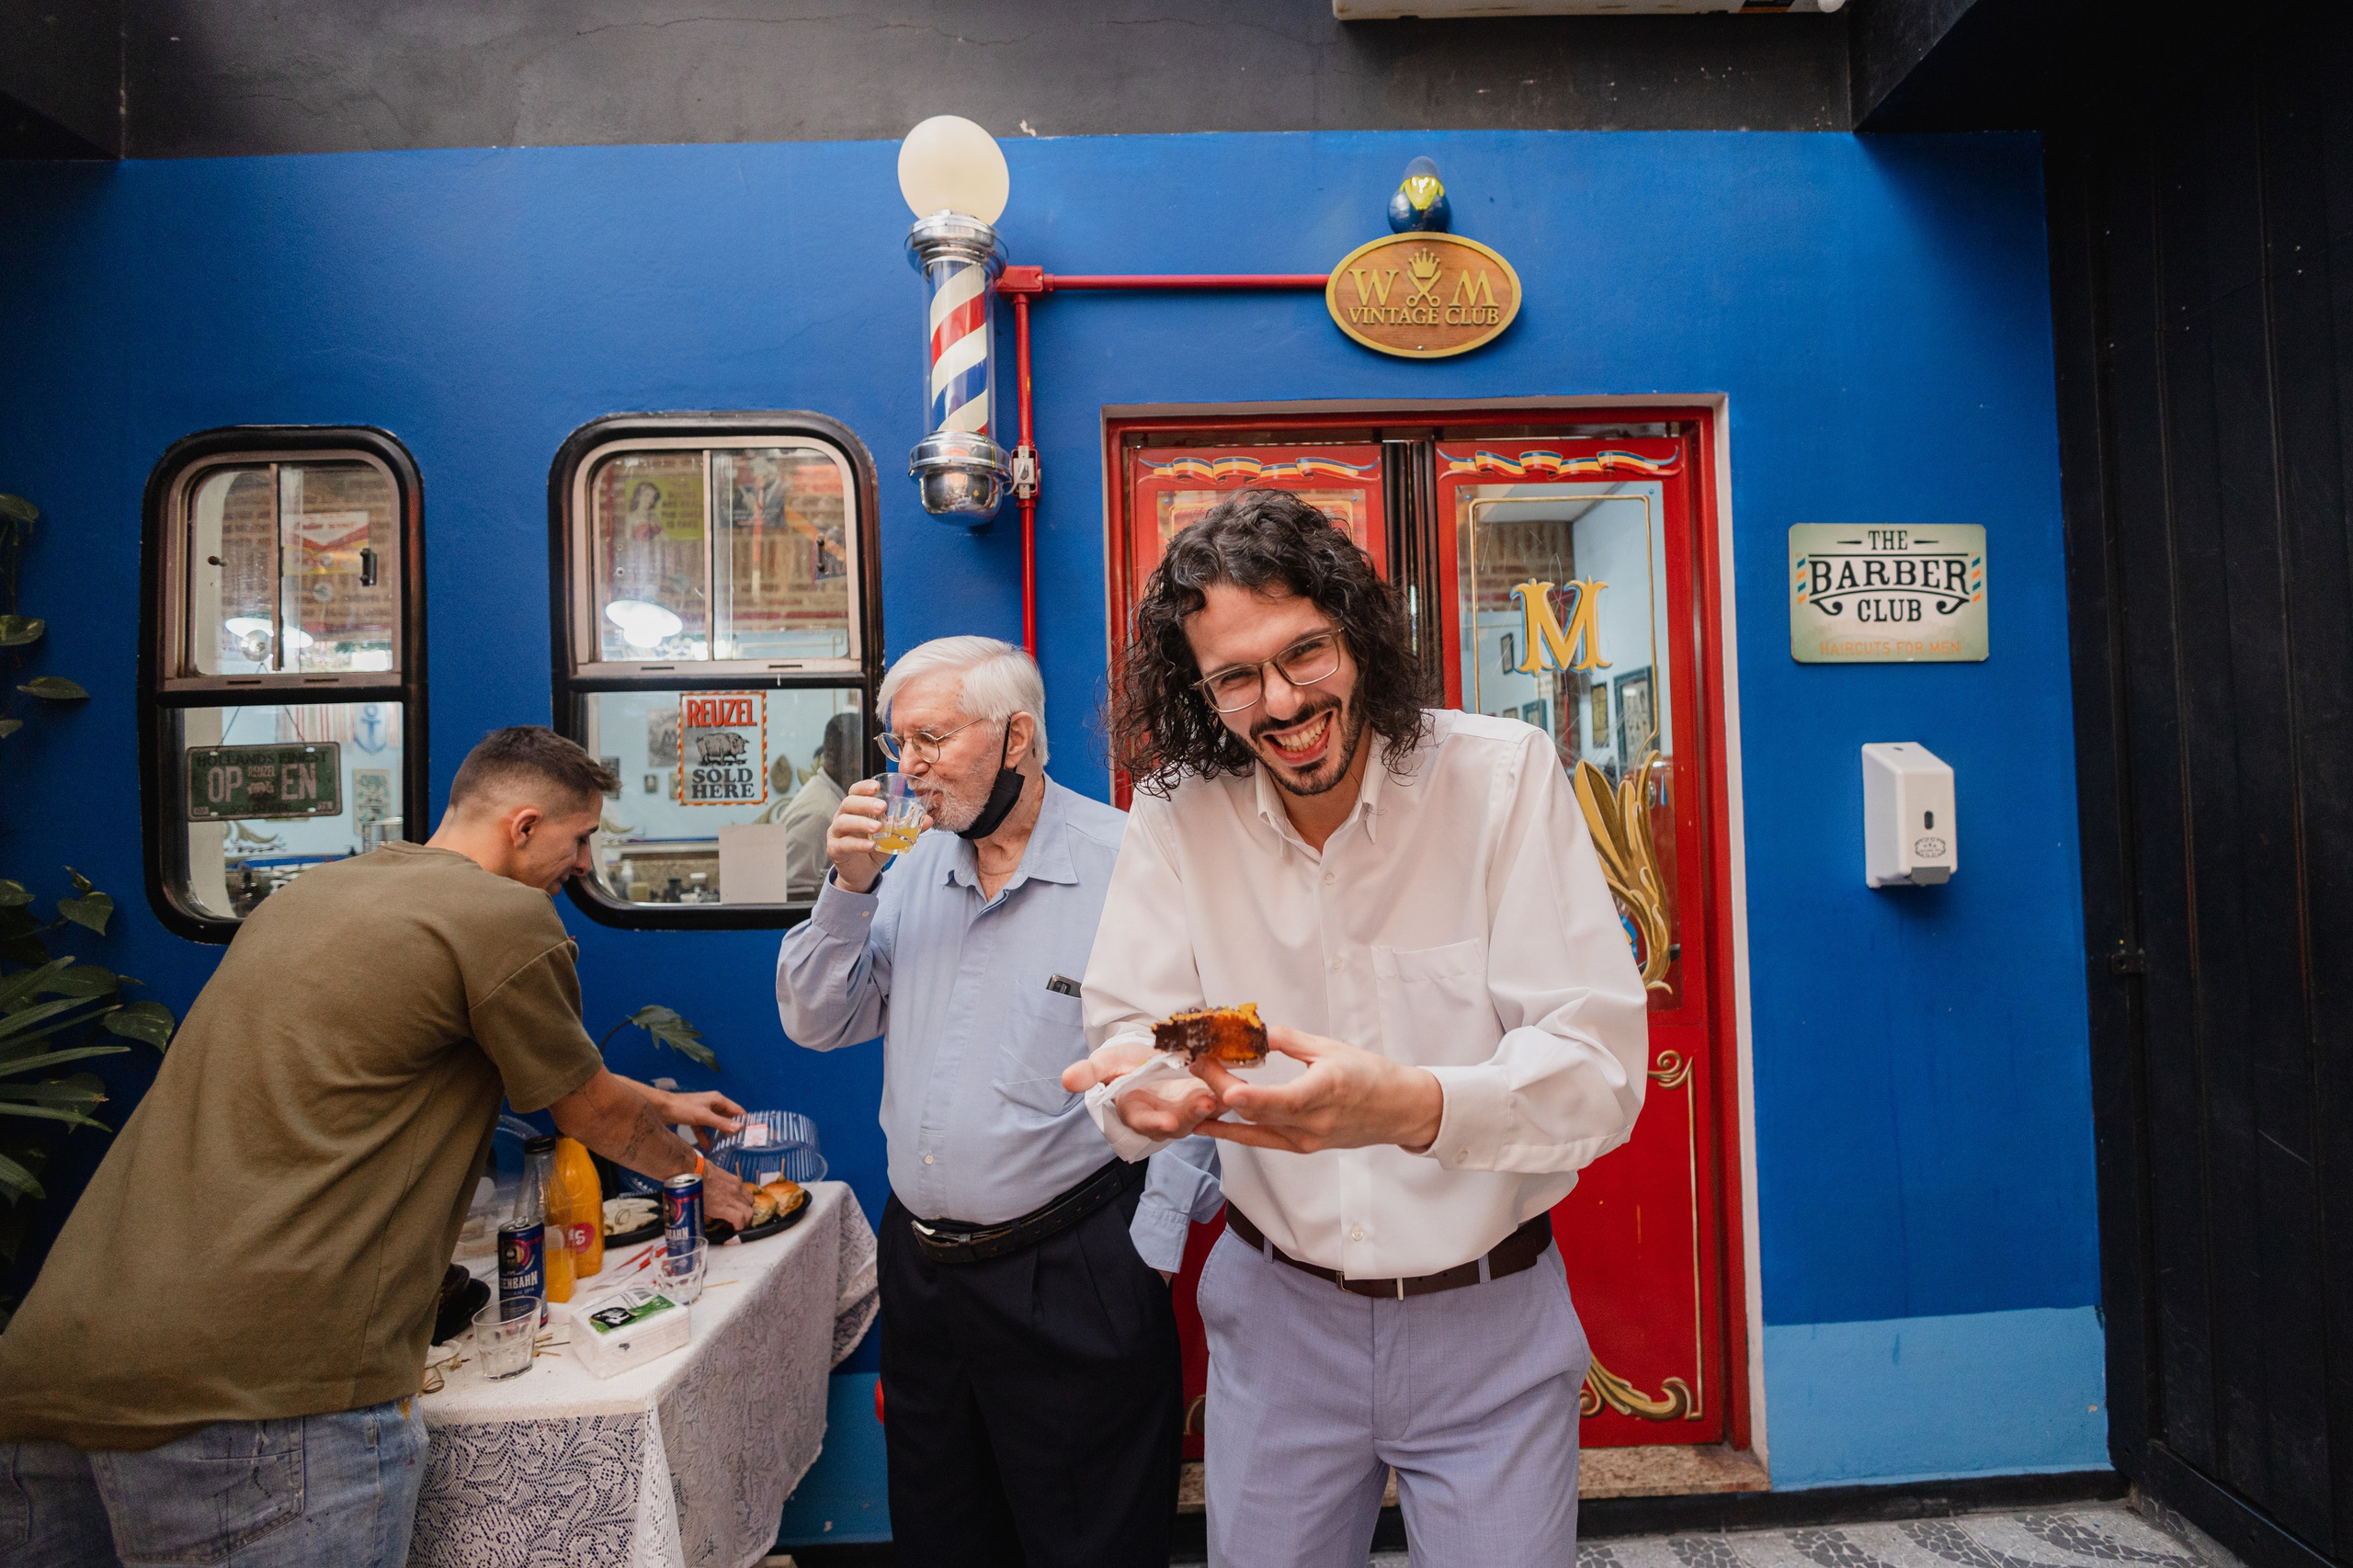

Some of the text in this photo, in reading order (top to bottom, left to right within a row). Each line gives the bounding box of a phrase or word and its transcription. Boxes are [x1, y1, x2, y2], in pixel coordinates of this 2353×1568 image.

[1348, 268, 1499, 307] W M
[1348, 307, 1499, 325] VINTAGE CLUB
[1869, 530, 1908, 551] THE
[1808, 559, 1970, 597] BARBER
[1858, 599, 1922, 622] CLUB
[1510, 574, 1613, 678] M
[1820, 641, 1961, 655] HAIRCUTS FOR MEN
[687, 699, 757, 728] REUZEL
[196, 754, 275, 767] HOLLANDS
[692, 768, 754, 784] SOLD
[691, 783, 755, 799] HERE
